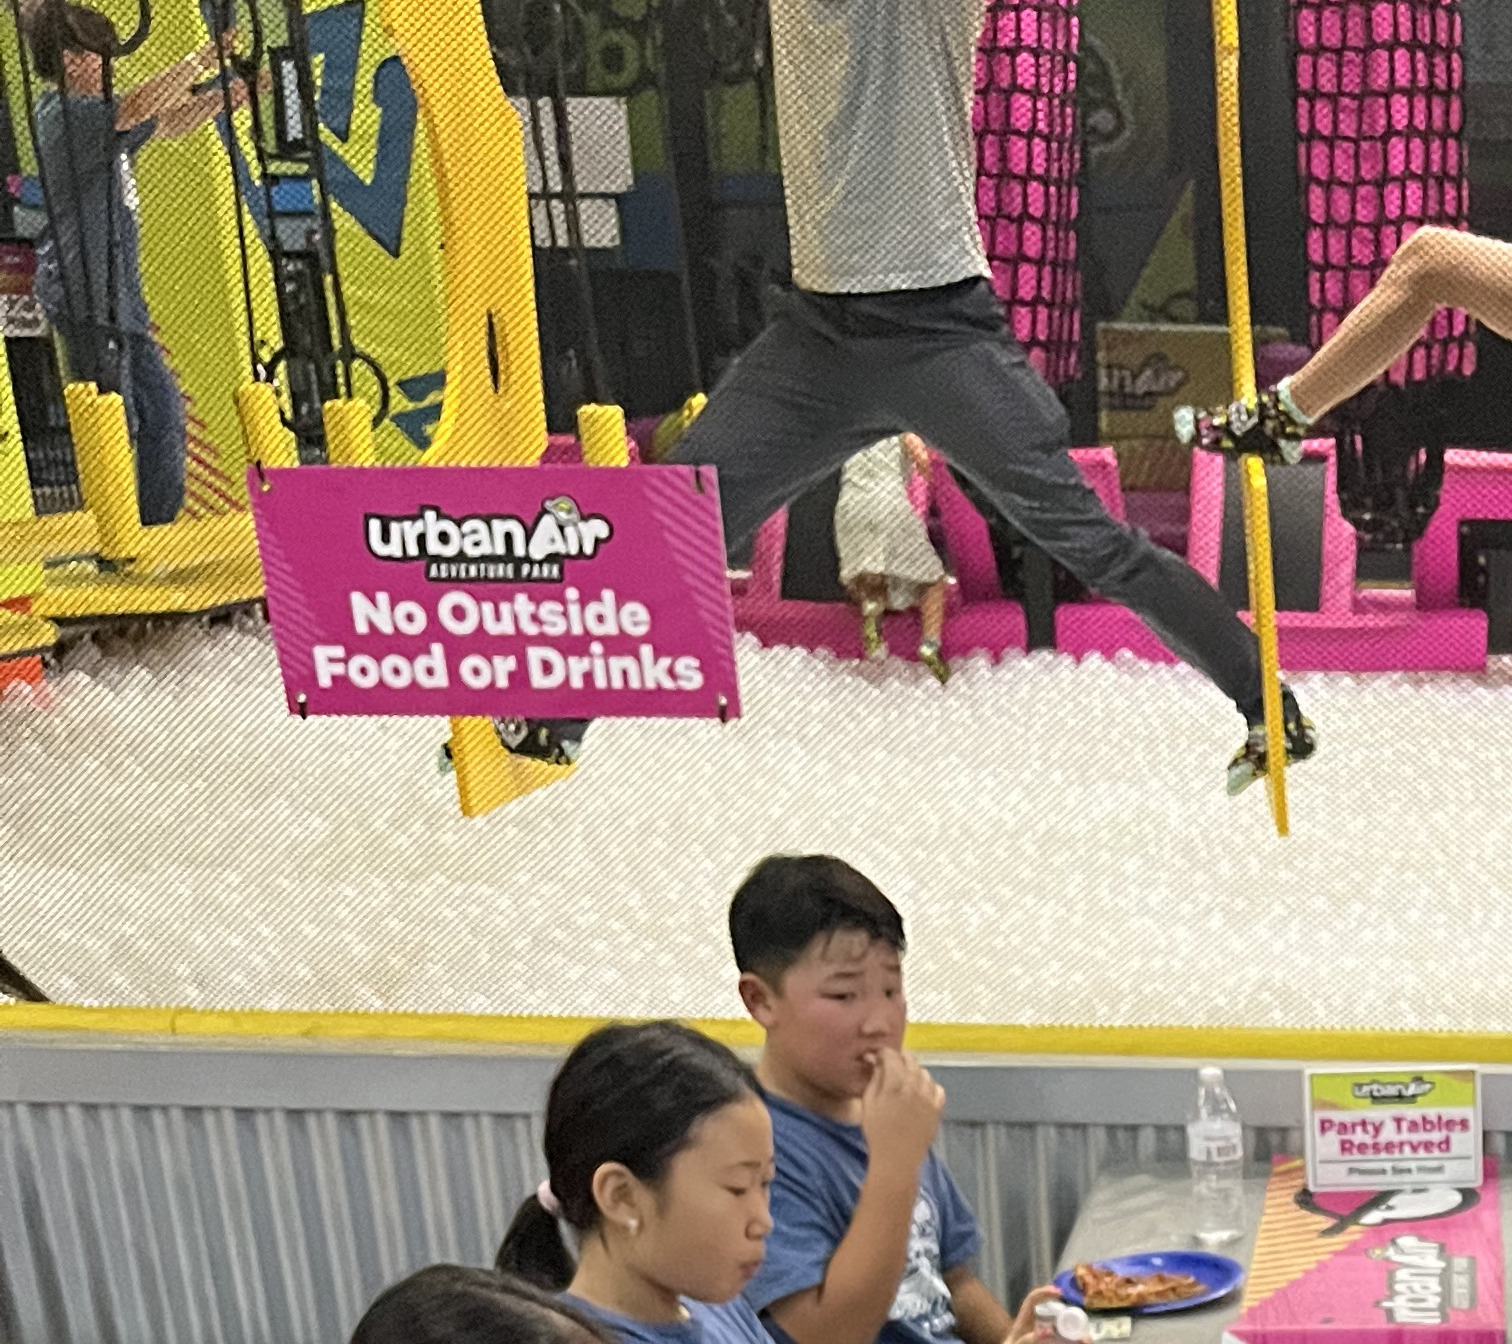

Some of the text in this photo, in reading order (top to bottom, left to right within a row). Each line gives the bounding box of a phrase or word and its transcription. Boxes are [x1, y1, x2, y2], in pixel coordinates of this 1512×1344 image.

[367, 508, 611, 561] urbanAir
[429, 562, 561, 580] ADVENTURE PARK
[350, 587, 651, 637] No Outside
[312, 642, 703, 691] Food or Drinks
[1319, 1114, 1470, 1139] Party Tables
[1339, 1135, 1452, 1156] Reserved
